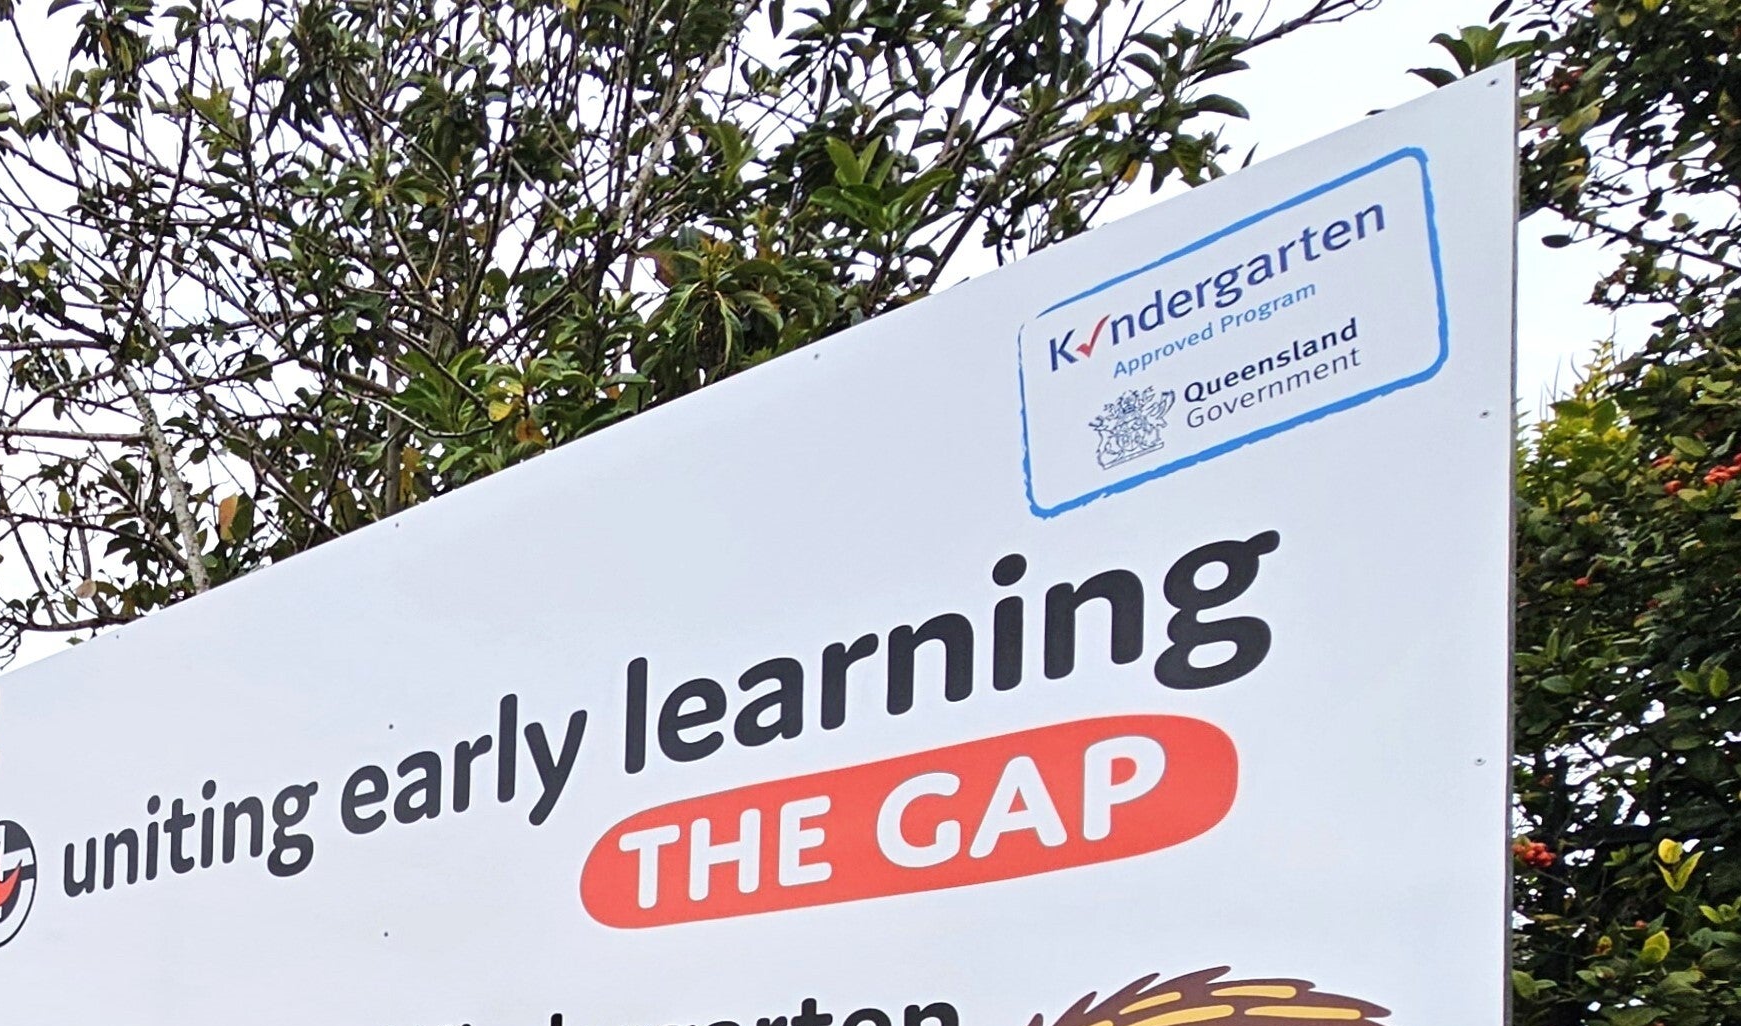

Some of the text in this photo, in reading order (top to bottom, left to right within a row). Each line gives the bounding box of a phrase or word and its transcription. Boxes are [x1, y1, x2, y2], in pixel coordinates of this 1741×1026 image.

[1112, 281, 1317, 379] Approved Program
[1183, 317, 1359, 404] Queensland
[1186, 346, 1362, 430] Government
[62, 529, 1282, 899] uniting early learning
[617, 735, 1167, 909] THE GAP
